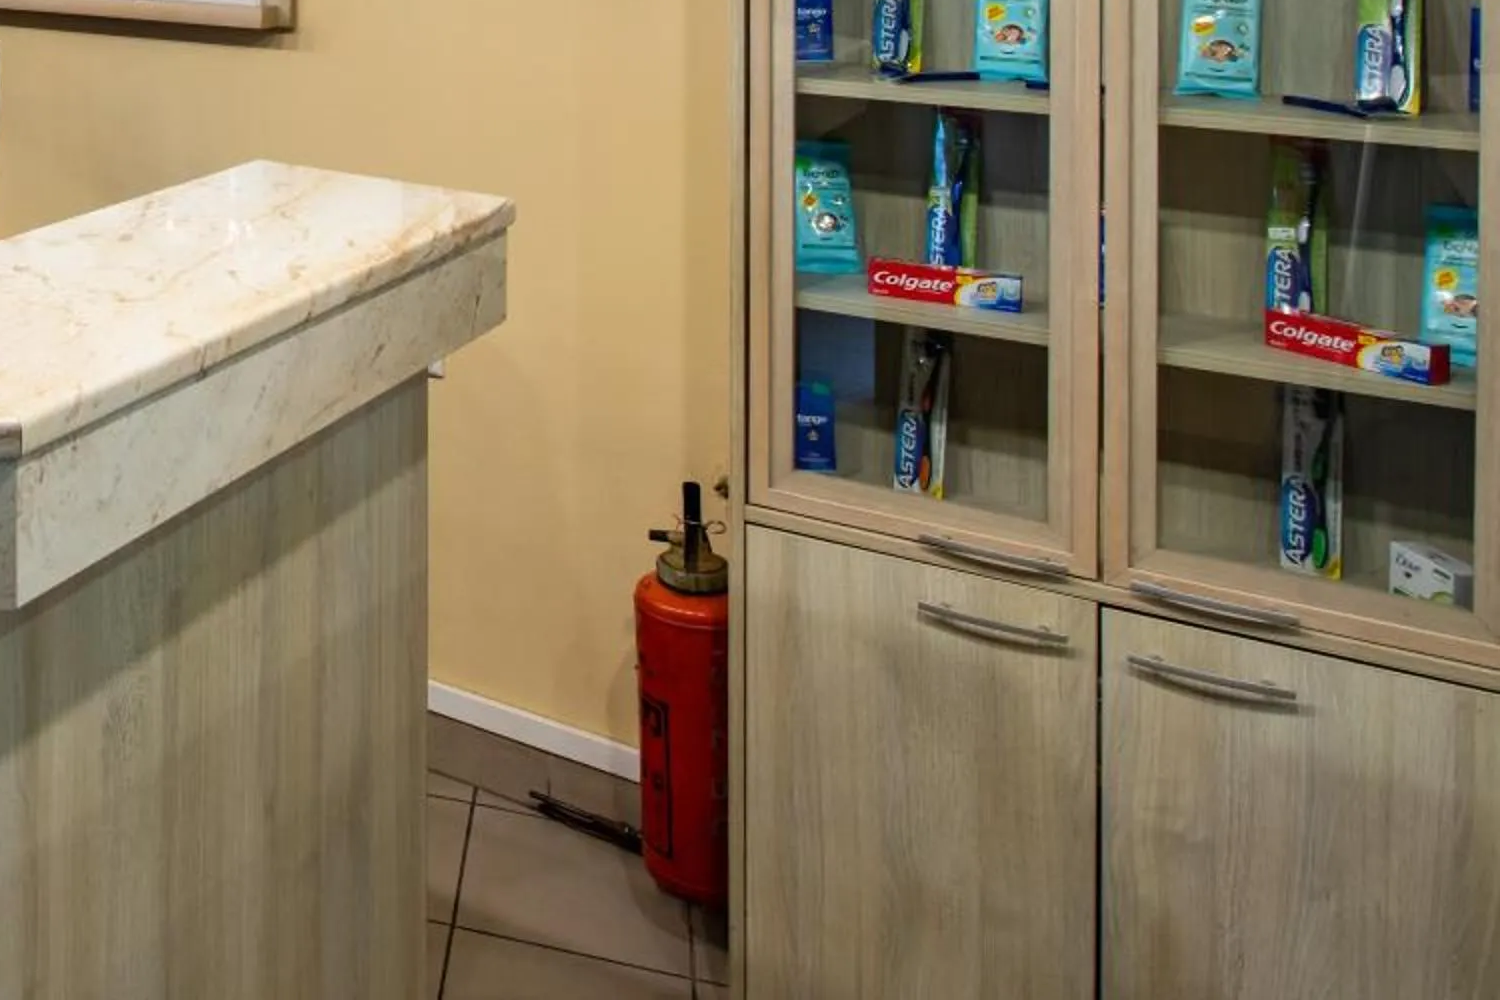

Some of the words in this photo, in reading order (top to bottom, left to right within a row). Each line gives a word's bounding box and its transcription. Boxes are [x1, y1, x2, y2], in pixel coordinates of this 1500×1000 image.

[1360, 27, 1385, 100] STERA
[930, 200, 949, 265] STERA
[873, 271, 952, 293] Colgate
[1273, 246, 1293, 311] TERA
[1269, 321, 1355, 353] Colgate
[899, 410, 918, 489] ASTERA
[1286, 475, 1307, 565] ASTERA
